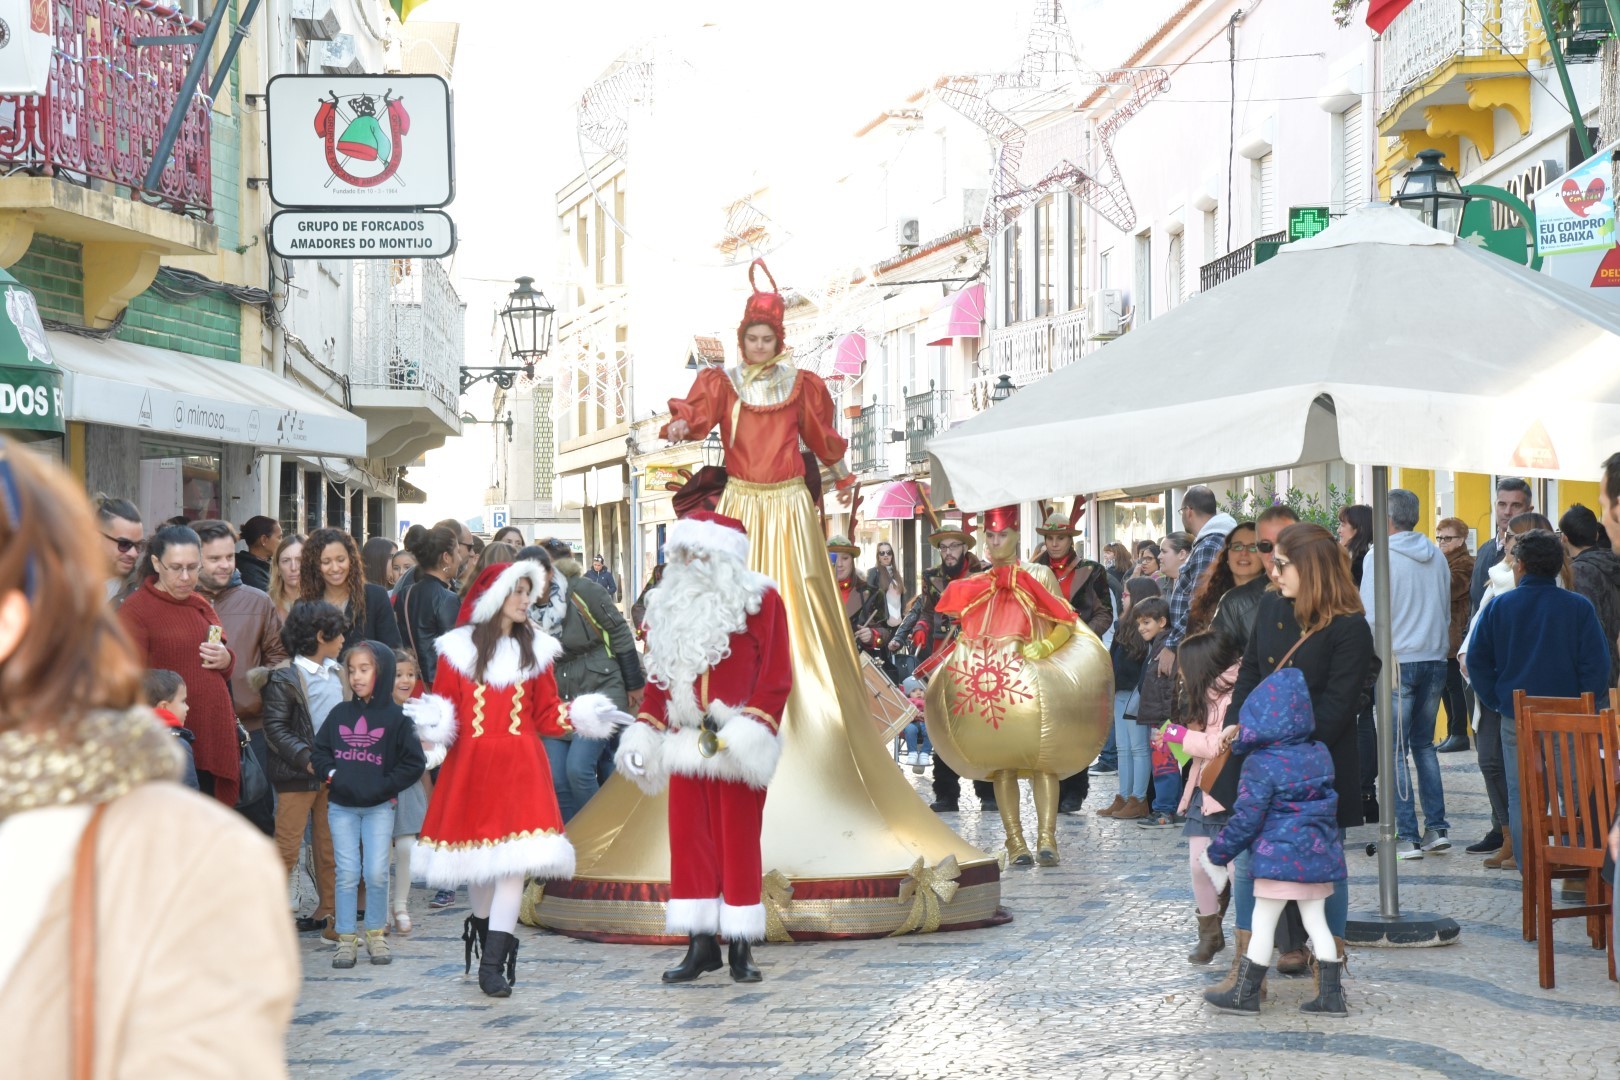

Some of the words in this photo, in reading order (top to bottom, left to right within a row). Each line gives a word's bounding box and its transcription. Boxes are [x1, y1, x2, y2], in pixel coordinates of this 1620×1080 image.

[297, 220, 339, 232] GRUPO
[342, 220, 357, 231] DE
[361, 220, 424, 231] FORCADOS
[1540, 223, 1555, 235] EU
[1557, 217, 1606, 233] COMPRO
[290, 238, 356, 249] AMADORES
[359, 238, 376, 249] DO
[379, 238, 433, 249] MONTIJO
[1540, 234, 1557, 245] NA
[1559, 230, 1595, 243] BAIXA
[187, 404, 225, 429] mimosa
[335, 749, 383, 765] adidas
